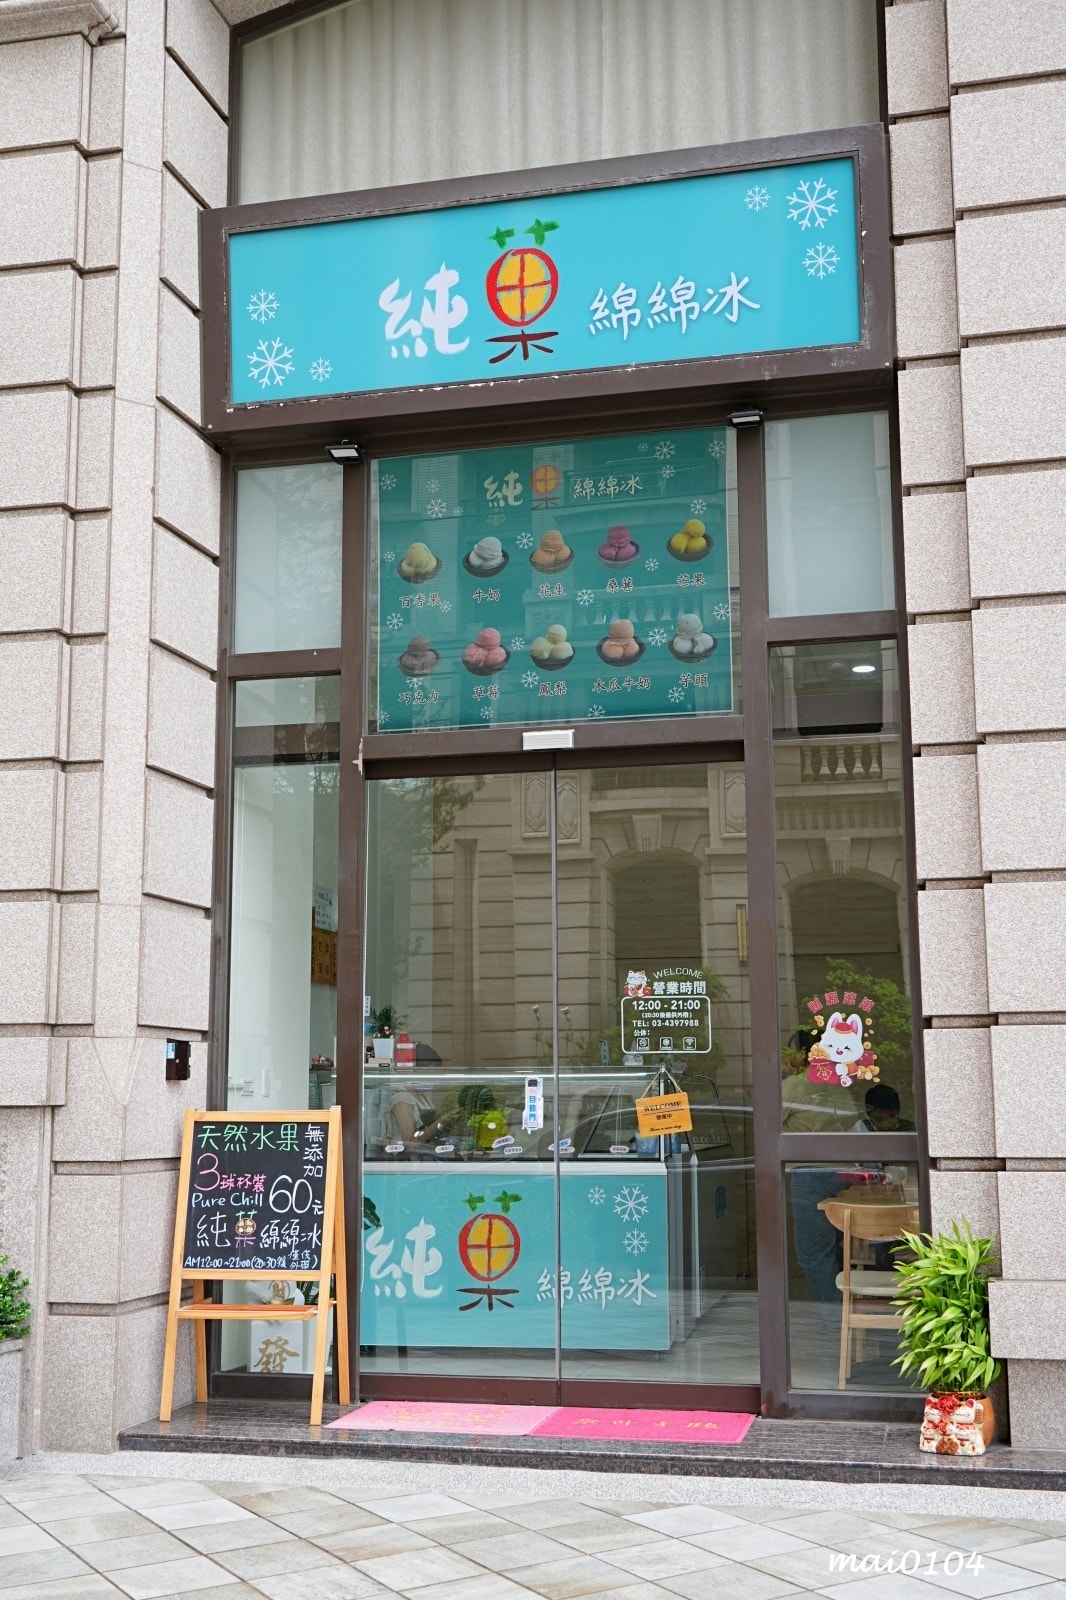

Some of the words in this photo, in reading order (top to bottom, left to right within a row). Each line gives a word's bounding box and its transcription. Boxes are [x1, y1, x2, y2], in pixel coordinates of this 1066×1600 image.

[589, 272, 760, 340] 綿綿冰
[573, 475, 644, 501] 綿綿冰
[677, 572, 706, 588] 芒果
[473, 588, 501, 603] 牛奶
[538, 583, 567, 598] 花生
[399, 593, 441, 608] 百香果
[592, 676, 651, 693] 木瓜牛奶
[679, 672, 709, 689] 芋頭
[399, 689, 439, 705] 巧克力
[473, 684, 500, 701] 草莓
[538, 681, 567, 697] 鳳梨
[653, 967, 704, 980] WELCOME
[653, 981, 706, 995] 營業時間
[632, 1000, 661, 1010] 12:00
[671, 1000, 700, 1010] 21:00
[644, 1101, 681, 1112] WELCOME
[197, 1124, 299, 1152] 天然水果
[303, 1123, 325, 1178] 無添加
[191, 1192, 226, 1208] Pure
[230, 1191, 263, 1207] Chill
[260, 1219, 322, 1251] 綿綿冰
[536, 1265, 657, 1310] 綿綿冰
